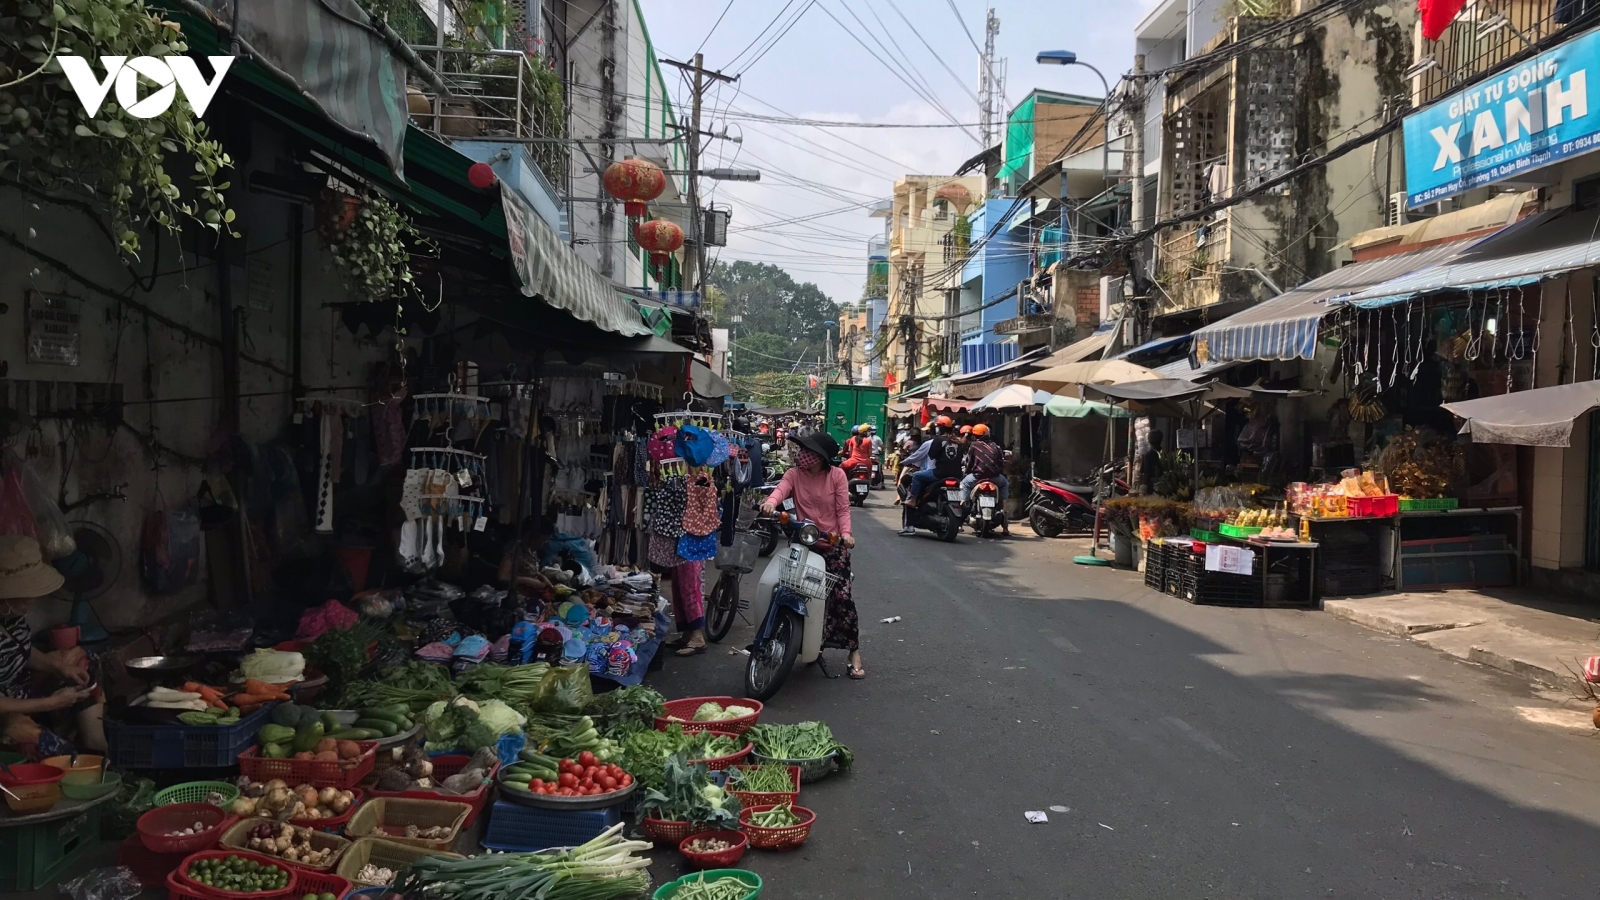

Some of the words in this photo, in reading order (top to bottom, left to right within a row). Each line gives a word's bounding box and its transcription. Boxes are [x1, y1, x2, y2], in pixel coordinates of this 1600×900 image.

[1485, 80, 1505, 104] TỰ
[1508, 59, 1557, 93] ĐỘNG
[1430, 69, 1588, 172] XANH
[1435, 186, 1448, 197] Phan
[1448, 182, 1459, 192] Huy
[1500, 164, 1515, 174] Quận
[1531, 151, 1550, 164] Thạnh
[1563, 142, 1574, 153] ĐT:
[1575, 136, 1591, 149] 0934
[1453, 153, 1504, 177] Professional
[1514, 133, 1558, 155] Washing
